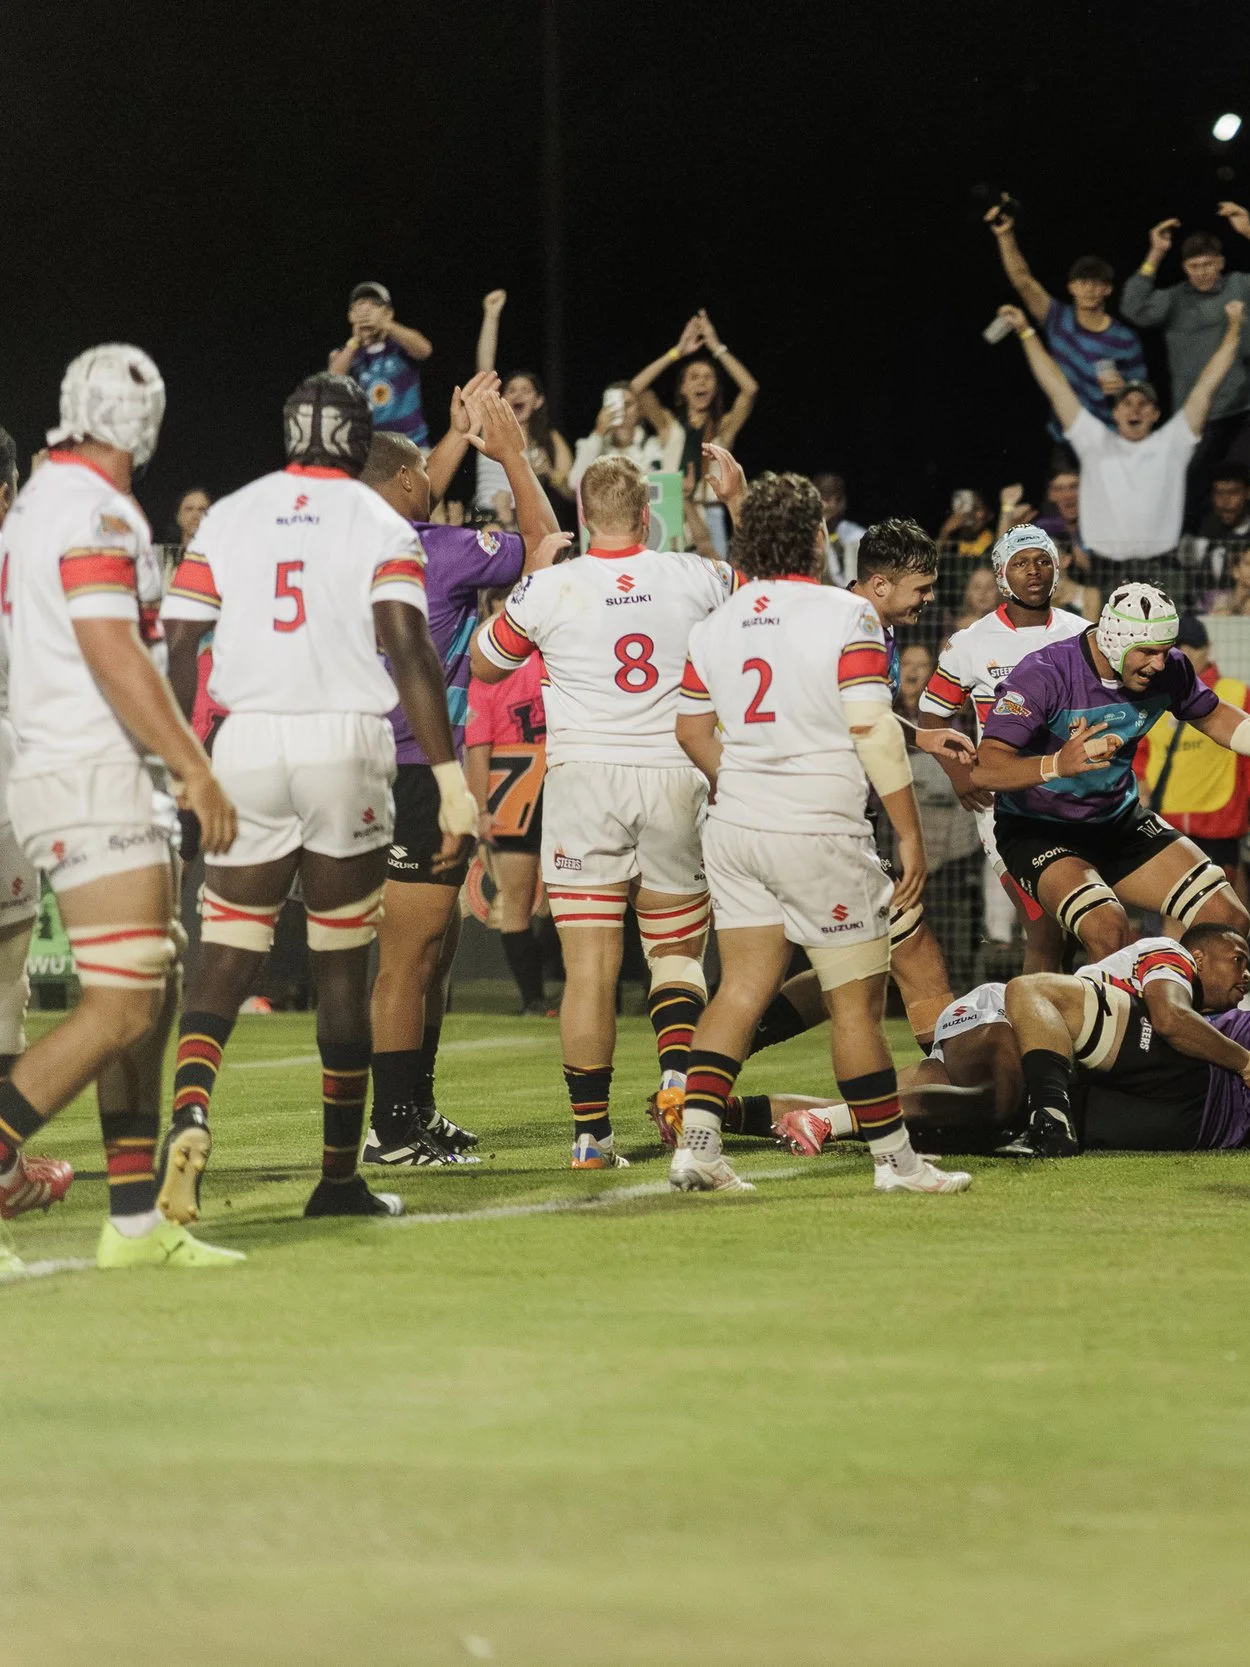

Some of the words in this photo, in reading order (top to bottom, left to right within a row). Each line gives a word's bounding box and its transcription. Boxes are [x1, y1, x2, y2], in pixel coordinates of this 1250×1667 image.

[273, 560, 306, 632] 5
[605, 594, 652, 606] SUZUKI
[741, 617, 780, 628] SUZUKI
[614, 633, 659, 693] 8
[742, 658, 776, 724] 2
[387, 858, 419, 870] UZUKI
[555, 856, 581, 870] STEERS
[821, 921, 864, 934] SUZUKI
[942, 1014, 977, 1029] SUZUKI
